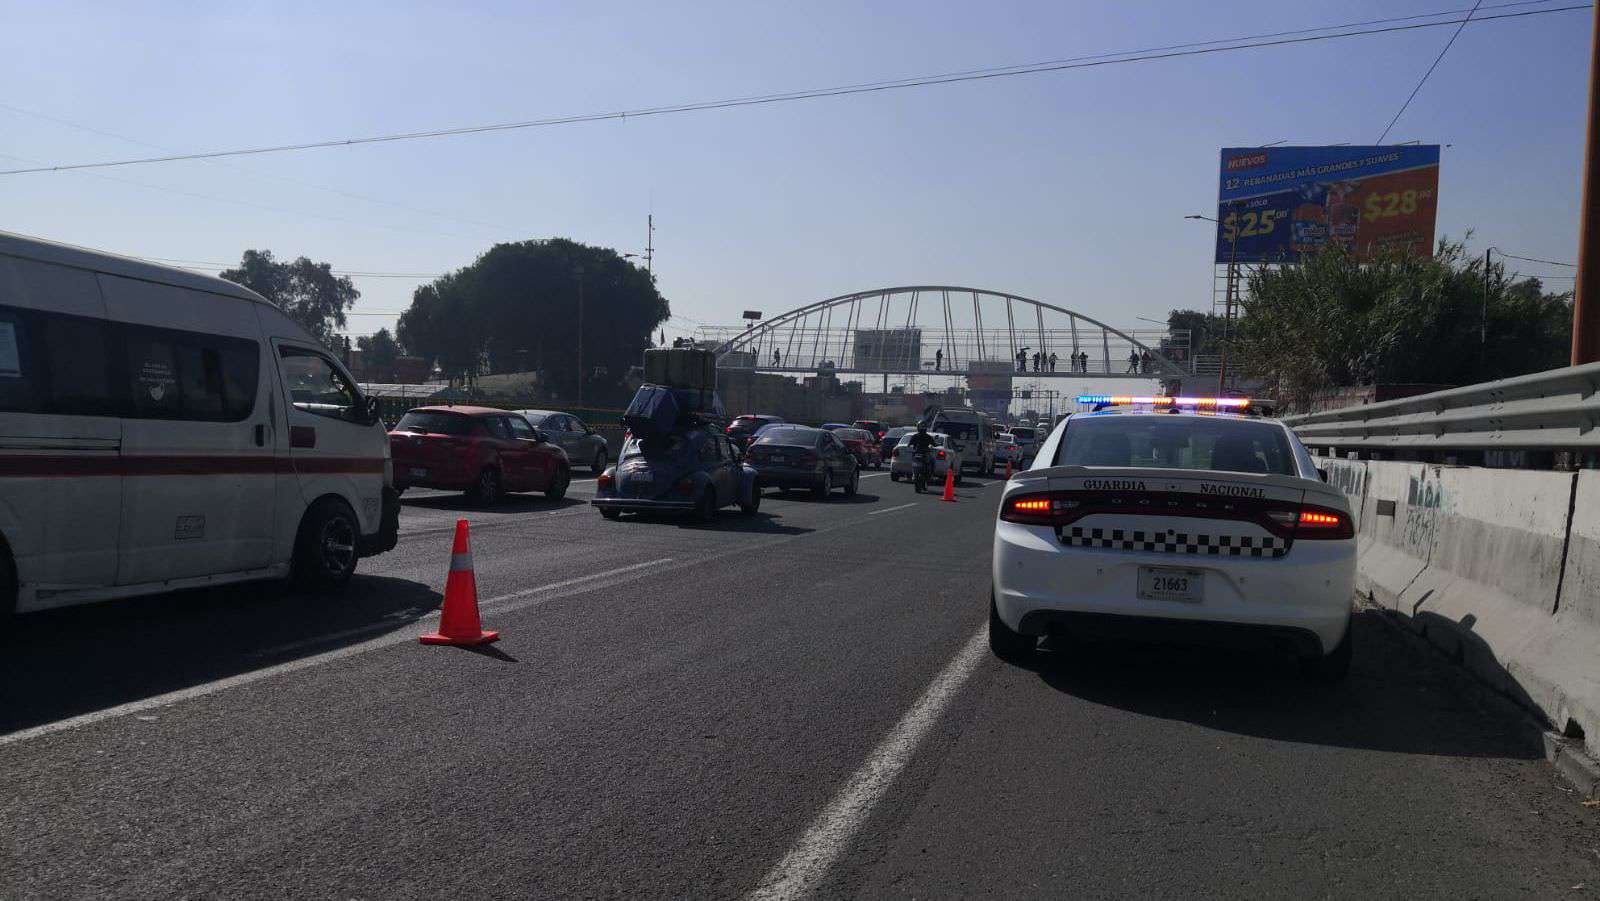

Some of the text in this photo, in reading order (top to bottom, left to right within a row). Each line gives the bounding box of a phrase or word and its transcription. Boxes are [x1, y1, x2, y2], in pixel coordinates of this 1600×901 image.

[1083, 480, 1266, 499] GUARDIA NACIONAL
[1152, 576, 1189, 592] 21663
